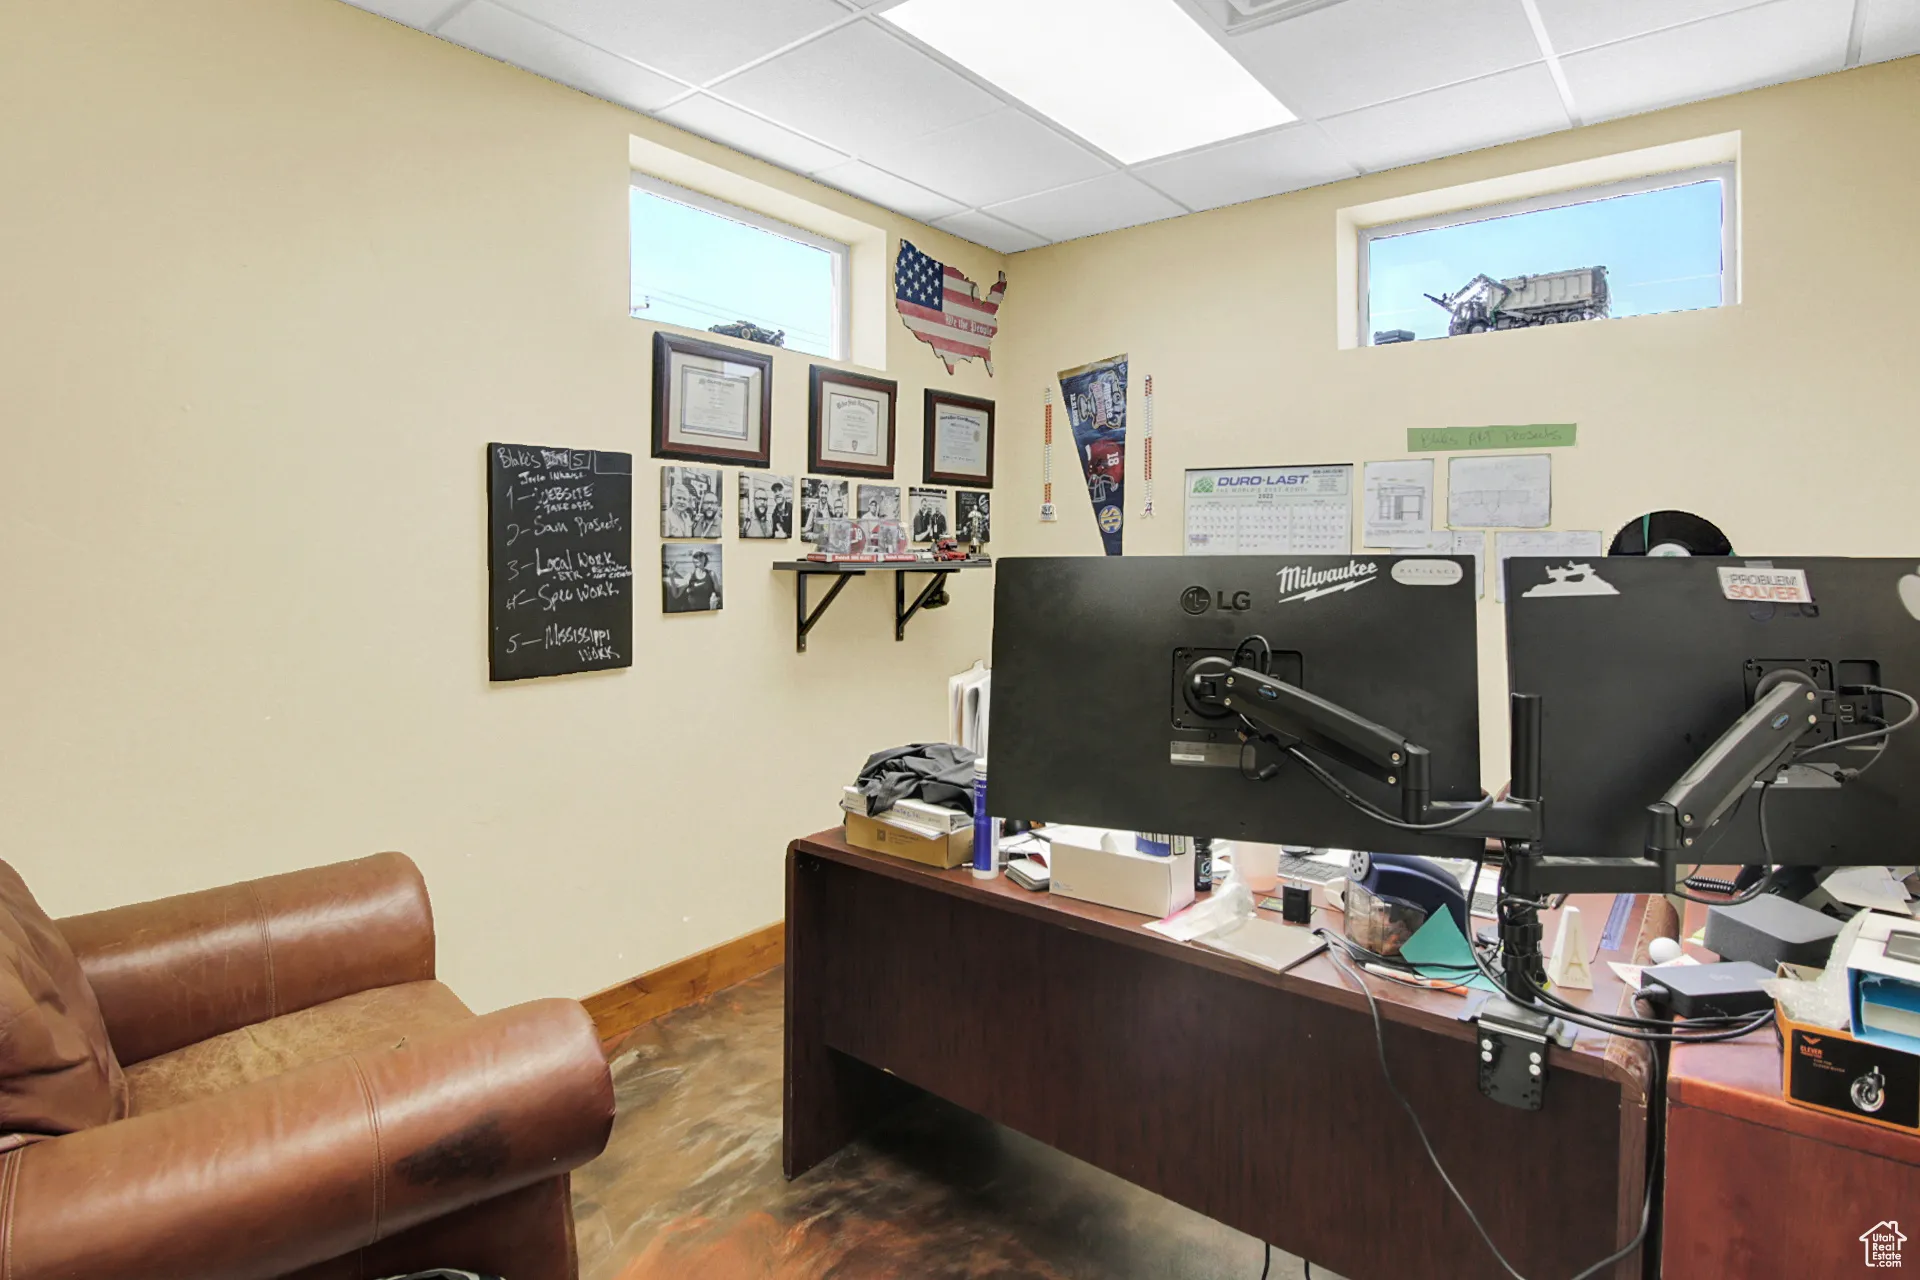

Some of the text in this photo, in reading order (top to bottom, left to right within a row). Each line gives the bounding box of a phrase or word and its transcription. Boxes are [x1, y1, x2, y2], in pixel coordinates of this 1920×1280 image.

[1102, 382, 1113, 418] Allstate
[1106, 451, 1119, 466] 18
[535, 547, 573, 576] Local
[1276, 560, 1378, 594] Milwaukee
[1730, 574, 1797, 586] PROBLEM
[1217, 590, 1250, 611] LG
[1728, 584, 1801, 600] SOLVER
